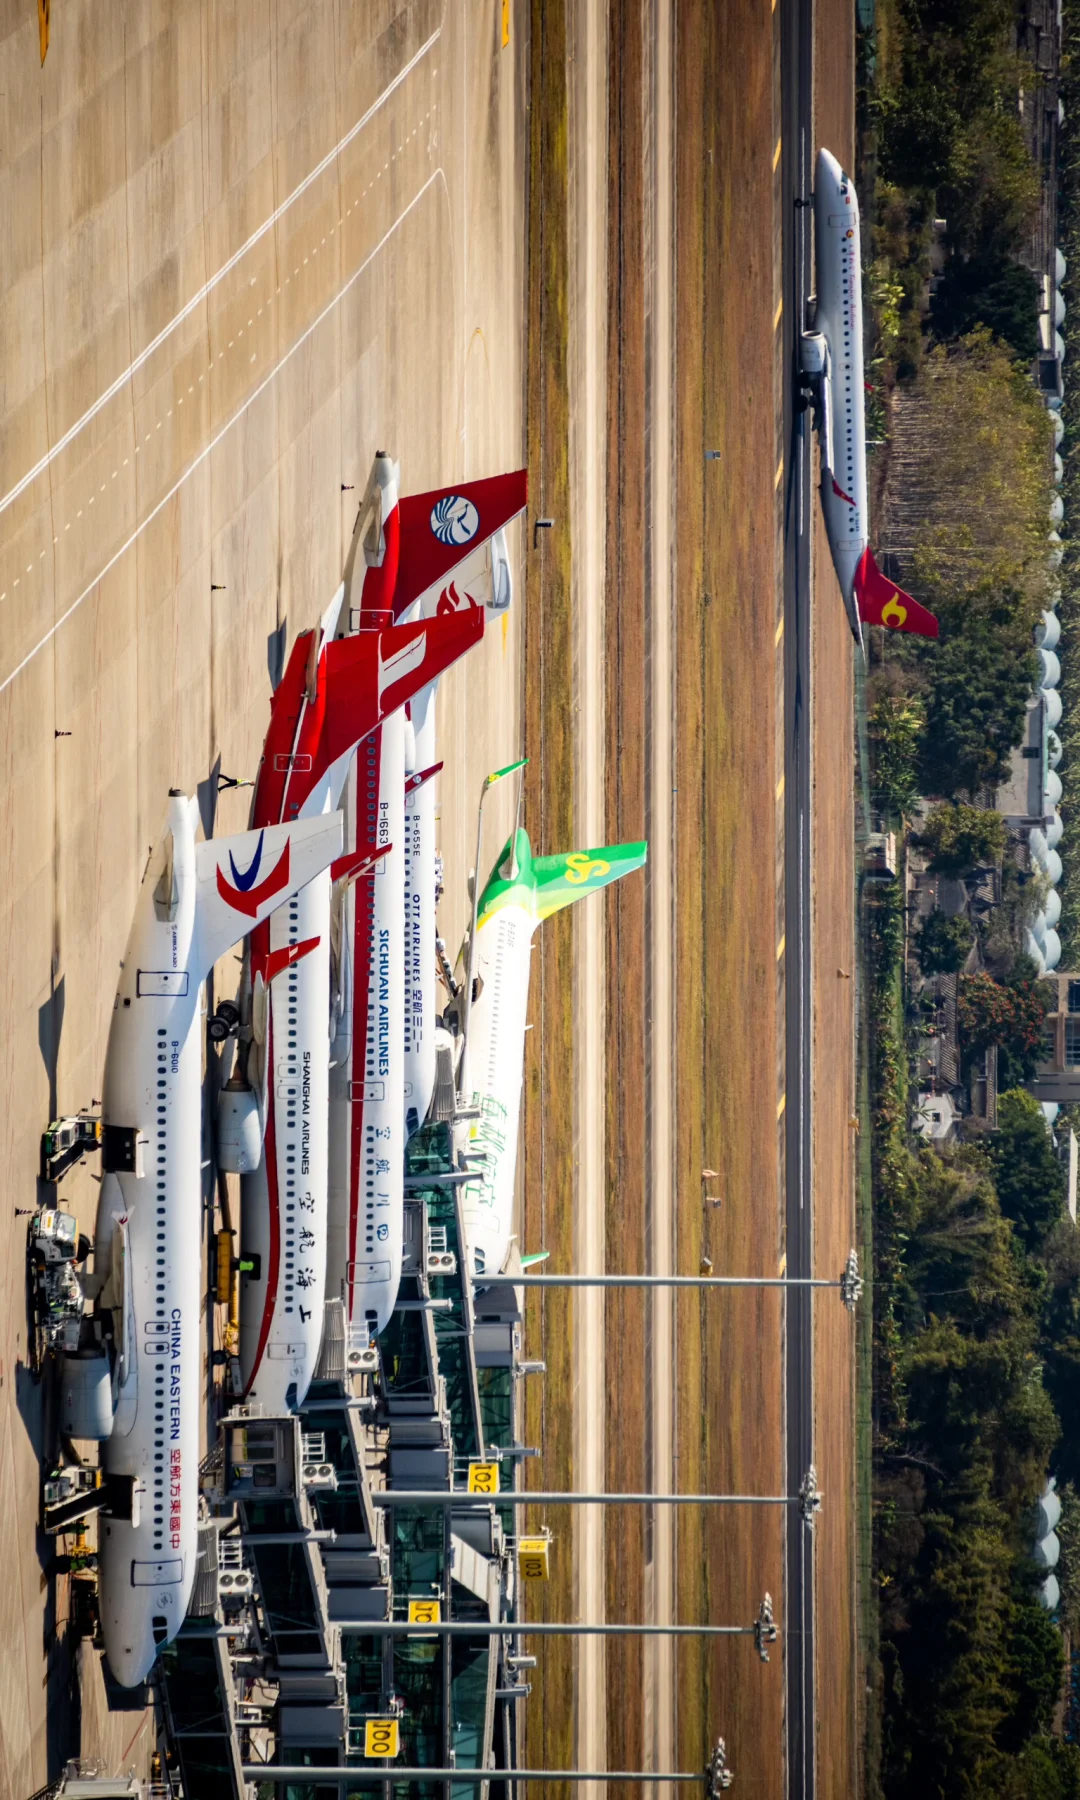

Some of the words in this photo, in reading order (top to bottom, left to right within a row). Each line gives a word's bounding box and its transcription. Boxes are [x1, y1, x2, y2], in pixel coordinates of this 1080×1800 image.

[380, 802, 389, 844] B-1663
[379, 930, 389, 1000] SICHUAN
[379, 1004, 389, 1076] AIRLINES
[302, 1052, 310, 1114] SHANGHAI
[301, 1120, 310, 1175] AIRLINES
[170, 1308, 181, 1359] CHINA
[170, 1364, 180, 1440] EASTERN
[474, 1465, 492, 1493] 102
[525, 1558, 542, 1577] 103
[415, 1607, 432, 1623] 10
[372, 1724, 391, 1753] 100
